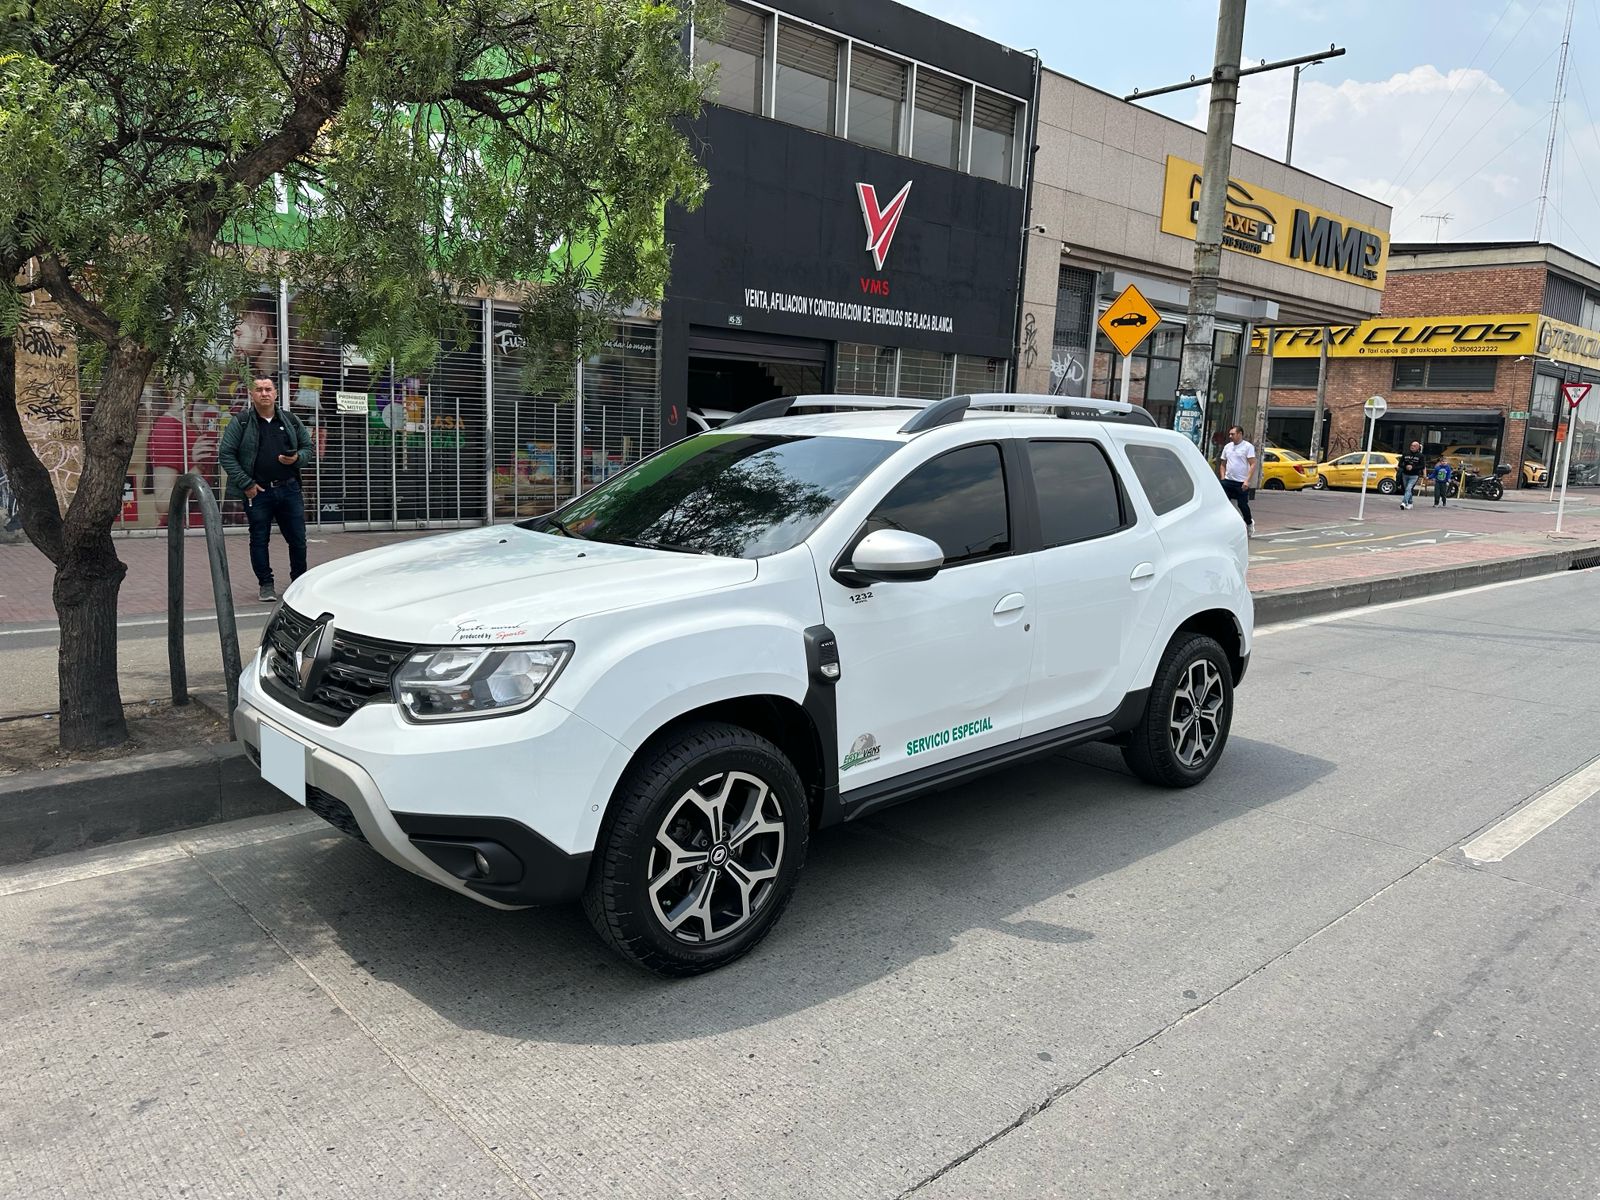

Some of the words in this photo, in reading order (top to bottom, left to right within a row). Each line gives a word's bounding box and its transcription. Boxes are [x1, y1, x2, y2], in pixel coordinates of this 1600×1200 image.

[1223, 213, 1259, 237] AXIS
[1290, 208, 1382, 278] MMP
[860, 277, 890, 296] VMS
[744, 288, 770, 314] VENTA,
[770, 292, 808, 314] AFILIACION
[808, 297, 814, 315] Y
[813, 299, 862, 322] CONTRATACION
[862, 306, 871, 323] DE
[872, 307, 903, 327] VEHICULOS
[904, 312, 912, 328] DE
[912, 312, 931, 330] PLACA
[932, 315, 953, 333] BLANCA
[1275, 327, 1355, 346] TAXI
[1363, 323, 1529, 344] CUPOS
[849, 591, 874, 602] 1232
[460, 632, 484, 640] produced
[906, 730, 950, 756] SERVICIO
[952, 716, 993, 741] ESPECIAL
